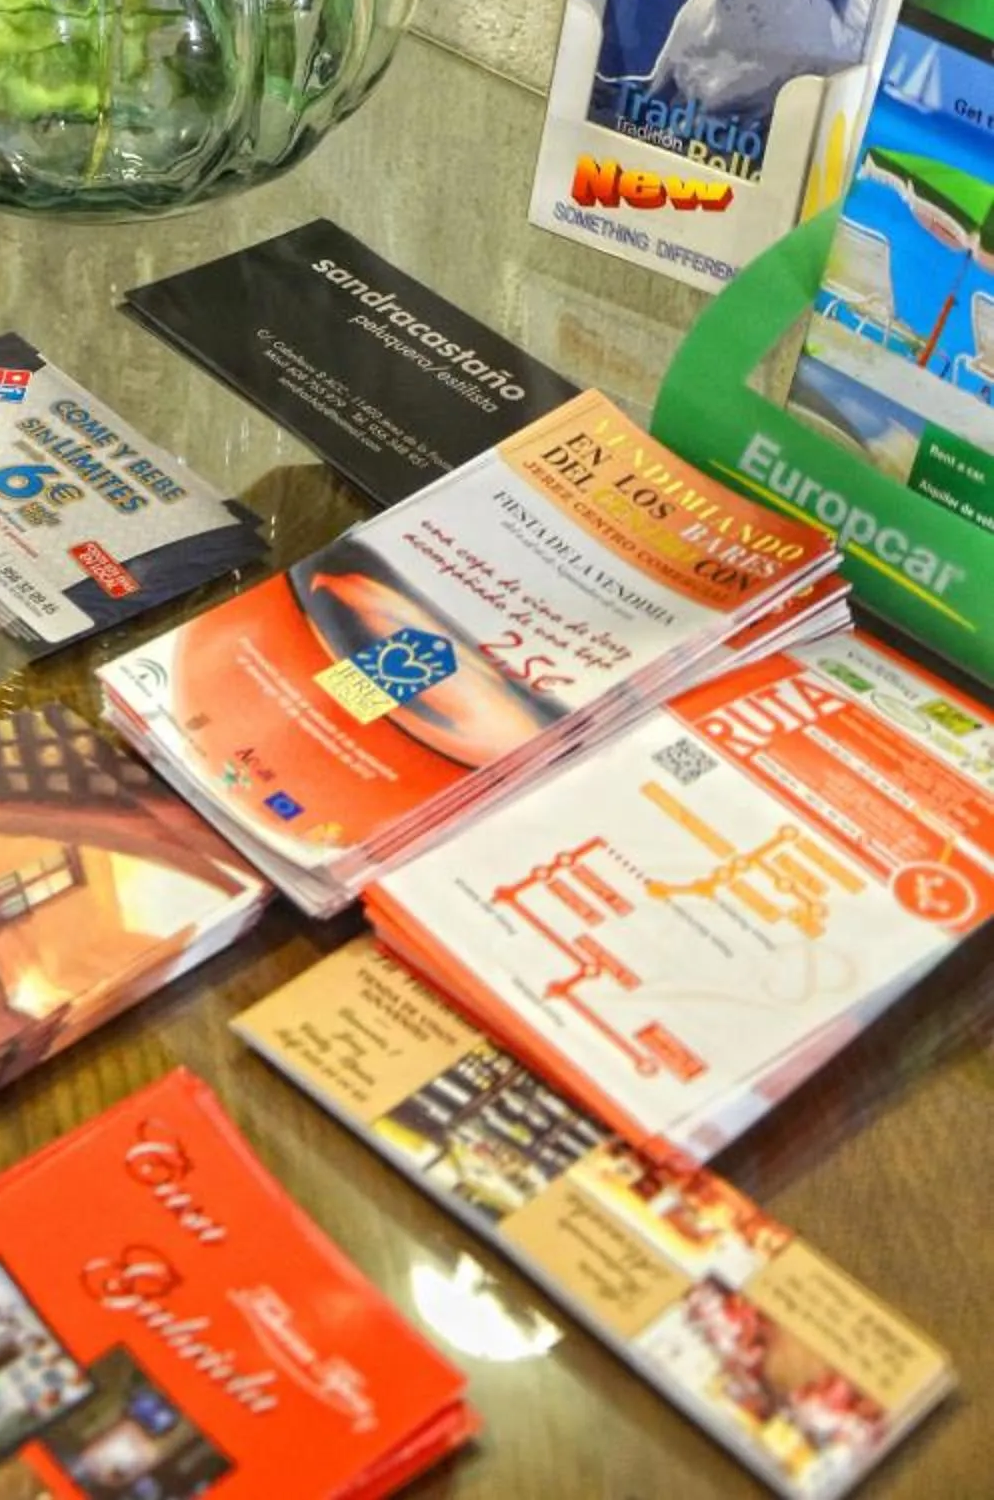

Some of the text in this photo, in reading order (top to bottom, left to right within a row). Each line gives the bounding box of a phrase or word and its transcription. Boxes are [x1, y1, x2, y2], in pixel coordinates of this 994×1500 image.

[616, 80, 761, 158] Tradició
[953, 97, 983, 124] Get
[570, 153, 734, 213] New
[553, 200, 739, 283] SOMETHING DIFFEREN
[311, 256, 526, 402] sandracastaño
[348, 313, 499, 414] peluquera/estilista
[16, 417, 60, 445] SIN
[54, 439, 150, 514] LÍMITES
[49, 399, 187, 503] COME Y BEBE
[593, 418, 805, 561] VENDIMIANDO
[522, 459, 577, 501] JEREZ
[573, 501, 637, 553] CENTRO
[541, 445, 596, 494] DEL
[692, 558, 753, 593] CON
[565, 431, 613, 467] EN
[612, 473, 677, 521] LOS
[679, 521, 782, 578] BARES
[736, 432, 967, 598] Europcar
[402, 532, 614, 670] acompañado de una tapa
[420, 519, 456, 547] una
[455, 547, 496, 580] copa
[497, 578, 522, 595] de
[521, 595, 564, 624] vino
[564, 620, 590, 637] de
[492, 489, 677, 628] FIESTA DE LA VENDIMIA
[703, 670, 848, 757] RUTA
